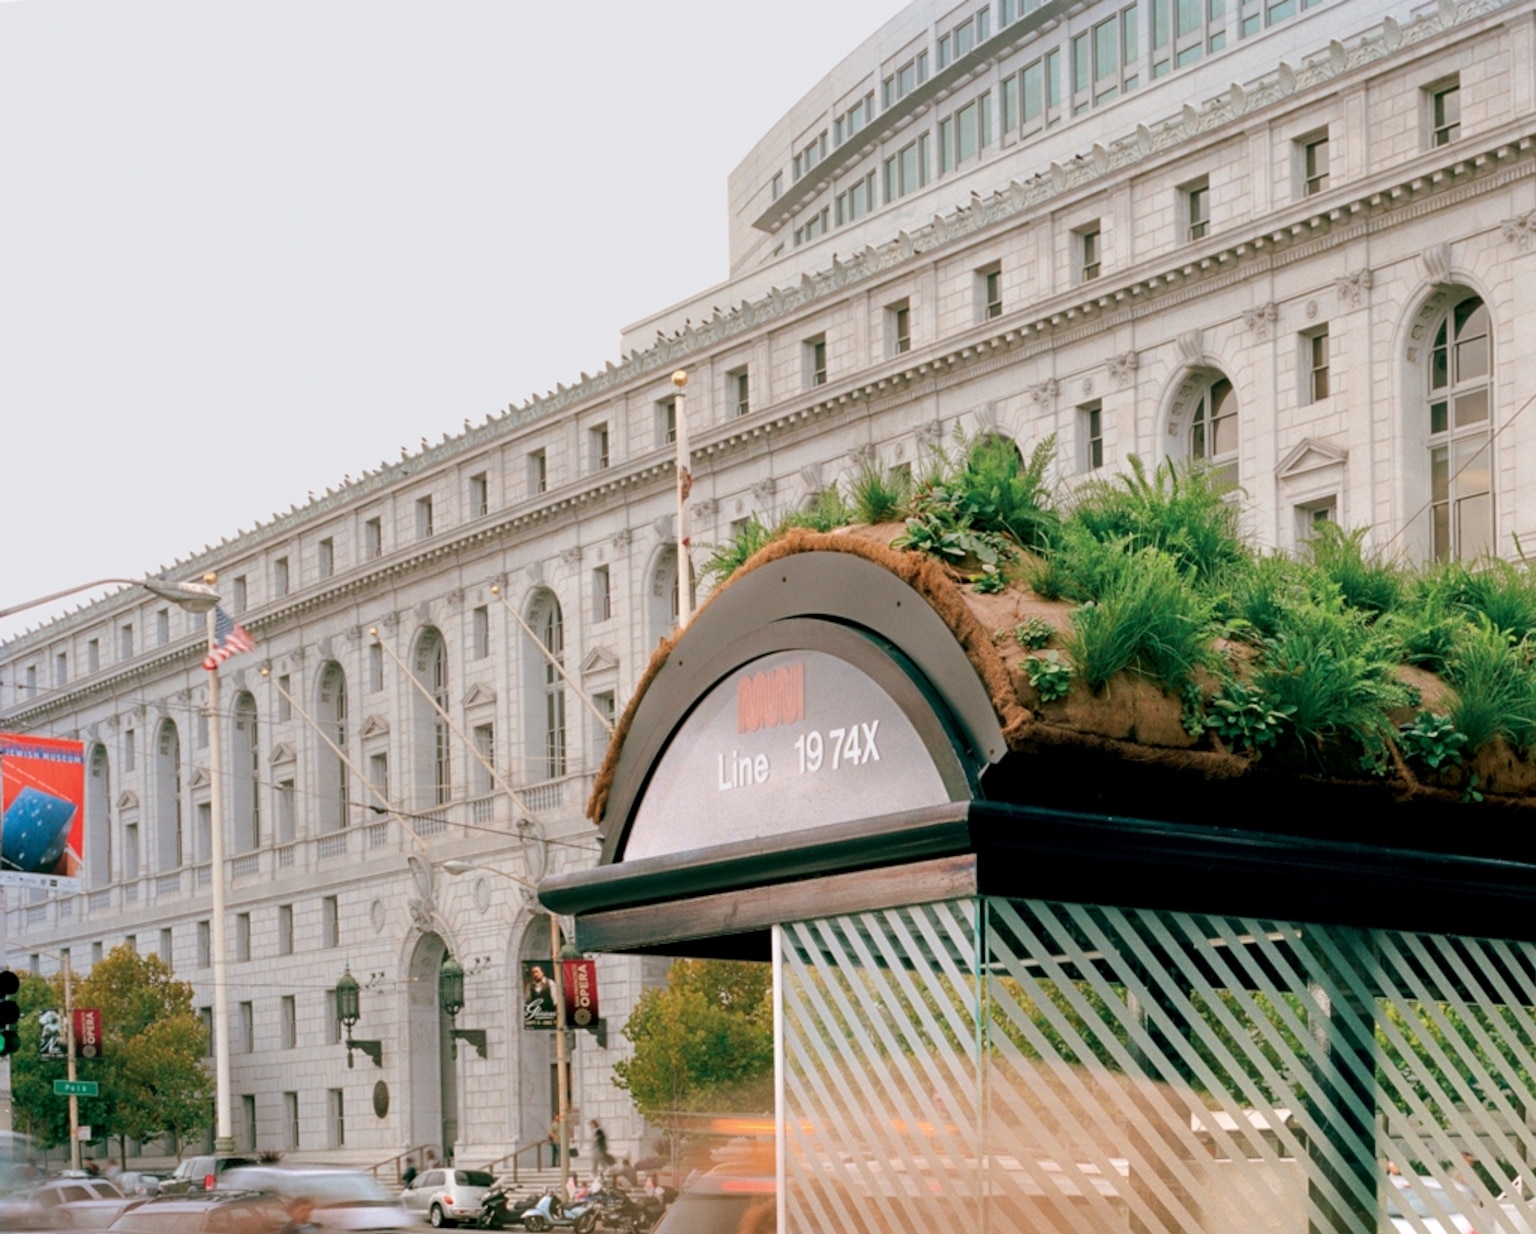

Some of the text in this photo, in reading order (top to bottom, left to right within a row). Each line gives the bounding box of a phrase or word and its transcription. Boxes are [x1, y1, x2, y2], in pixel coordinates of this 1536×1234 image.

[5, 747, 82, 764] JEWISH MUSEUM
[717, 749, 770, 791] Line
[578, 963, 591, 1008] OPERA
[85, 1011, 96, 1045] OPERA
[64, 1083, 87, 1093] Polk
